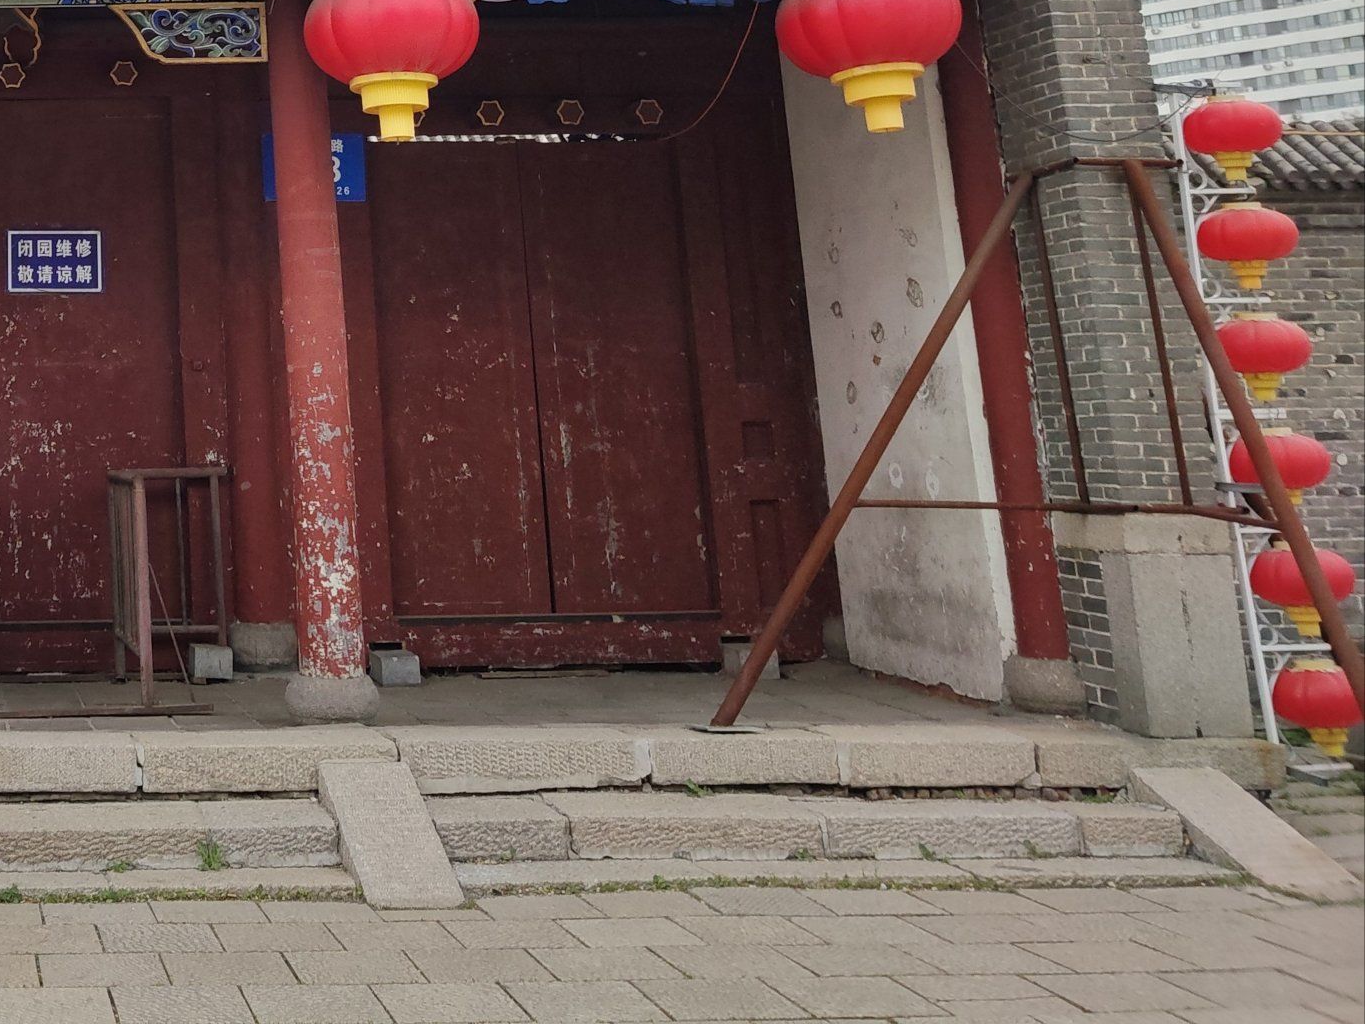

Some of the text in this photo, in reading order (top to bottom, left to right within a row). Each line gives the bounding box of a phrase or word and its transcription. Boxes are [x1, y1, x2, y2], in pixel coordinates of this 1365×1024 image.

[17, 238, 92, 258] 闭园维修
[17, 264, 93, 284] 敬请谅解
